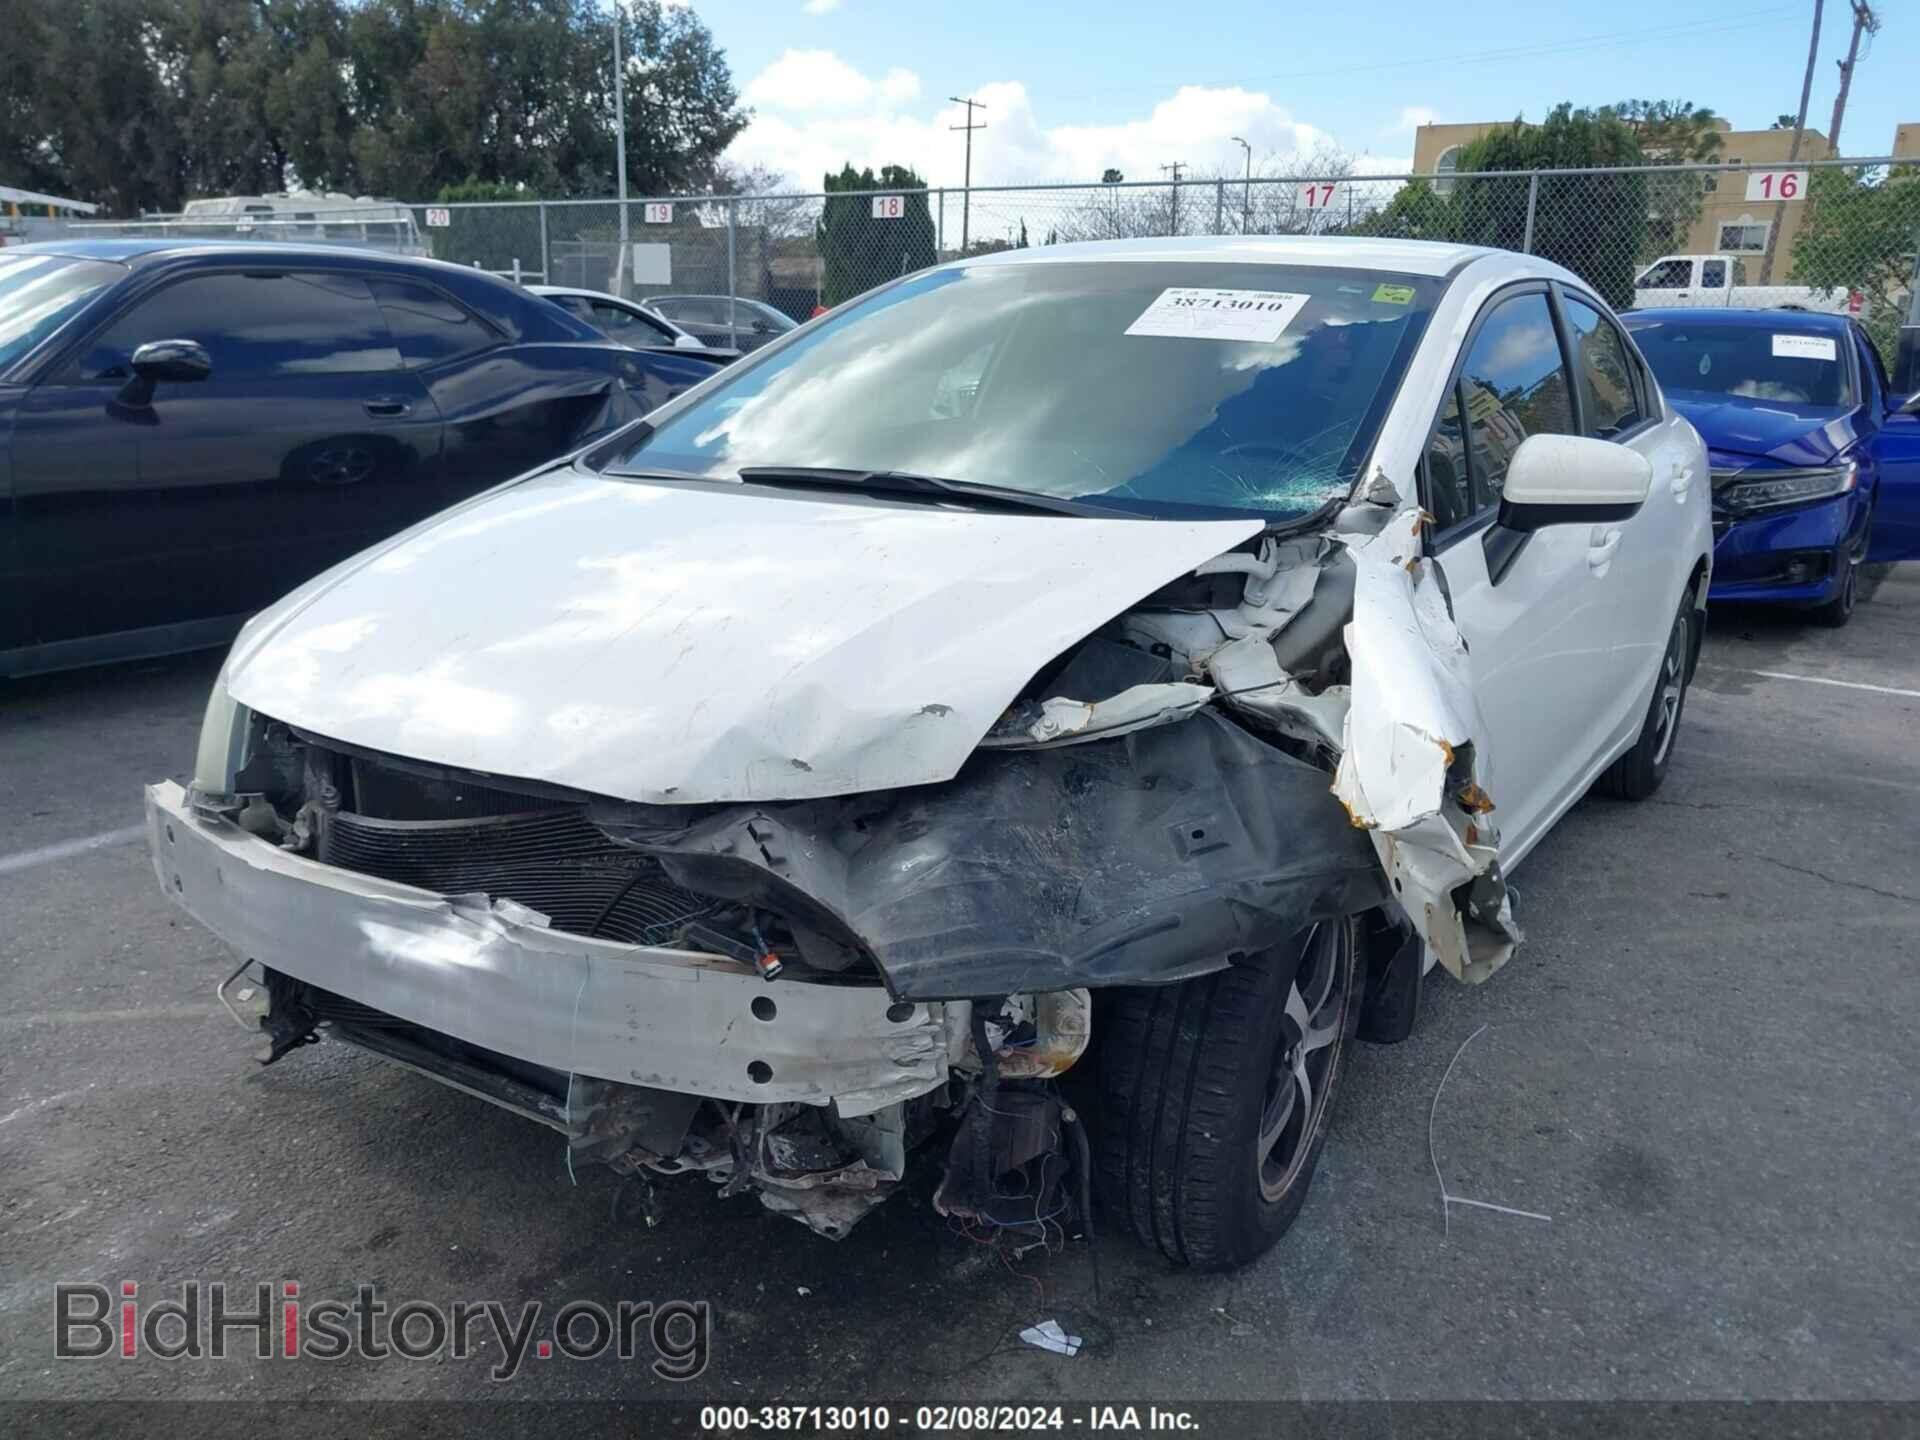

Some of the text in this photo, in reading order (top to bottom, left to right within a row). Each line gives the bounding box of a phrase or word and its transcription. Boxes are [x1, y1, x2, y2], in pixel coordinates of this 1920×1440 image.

[1760, 174, 1798, 199] 16
[1306, 185, 1335, 207] 17
[650, 205, 668, 221] 19
[879, 198, 898, 216] 18
[430, 210, 446, 224] 20
[1167, 297, 1283, 312] 38713010
